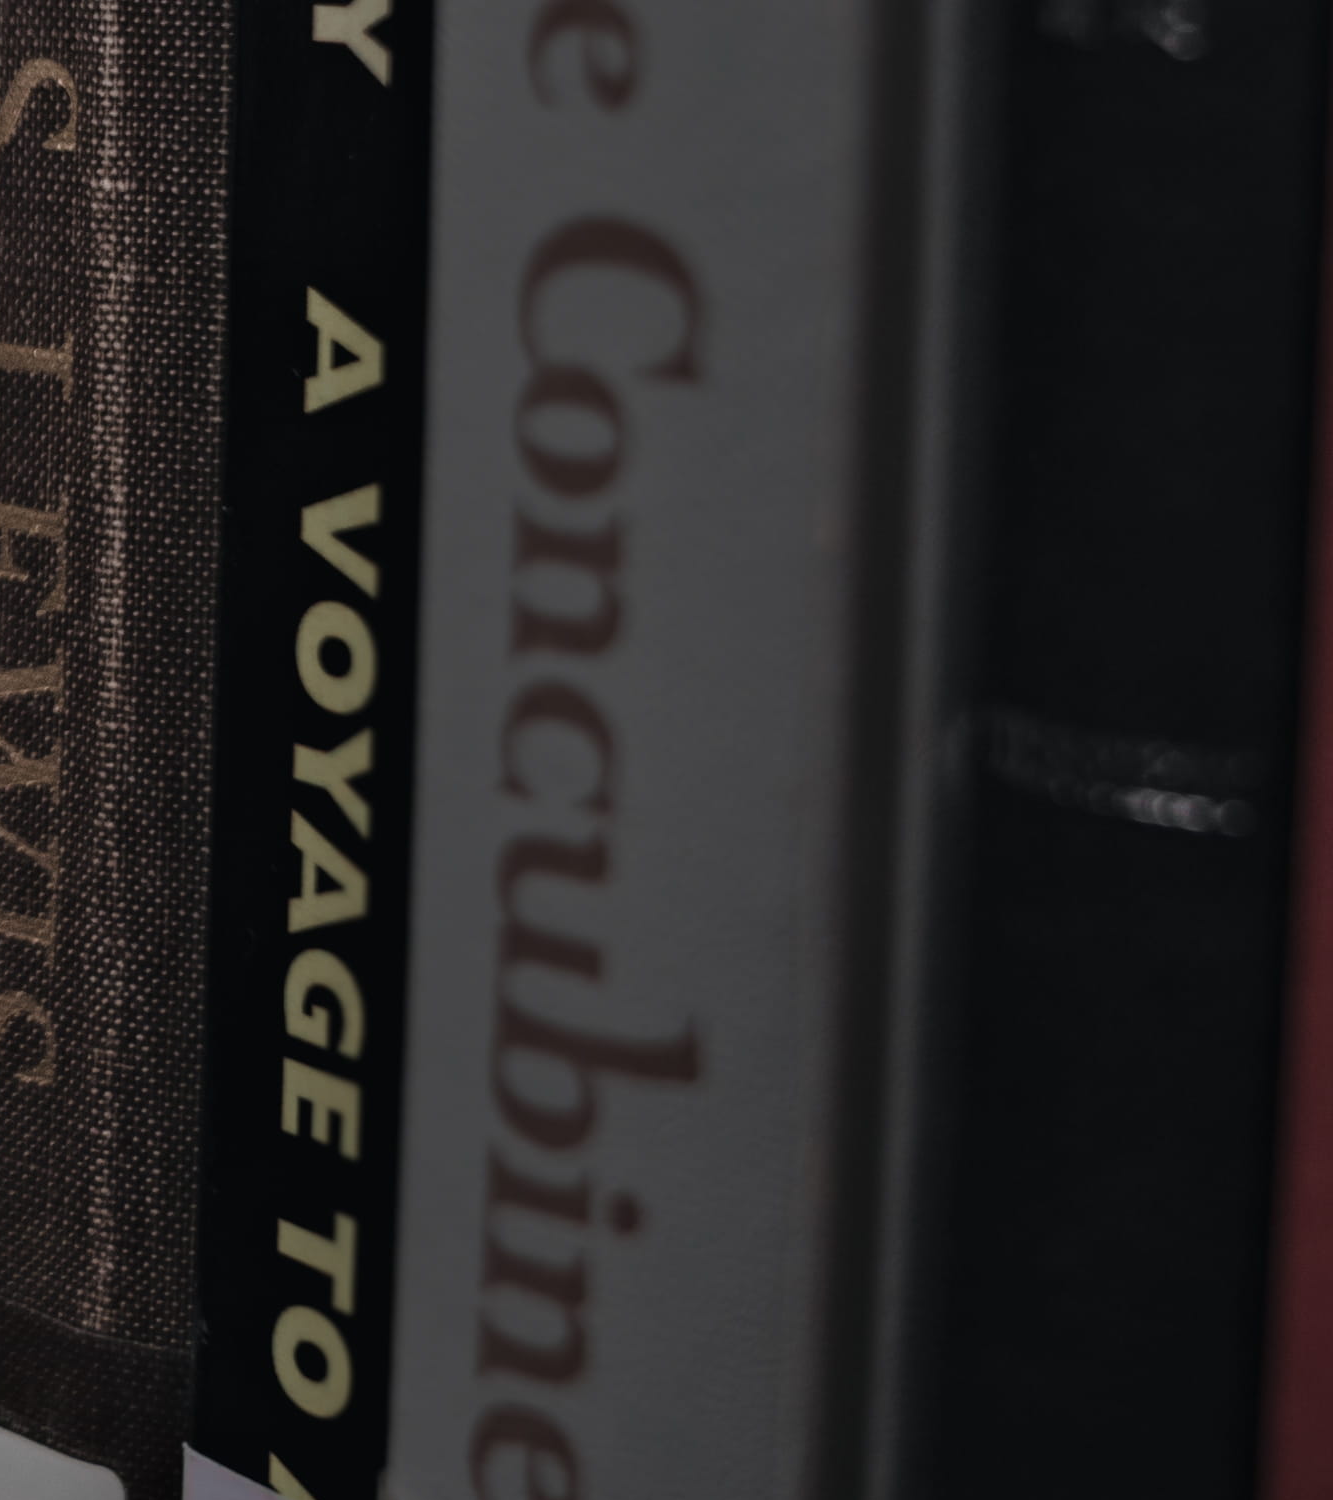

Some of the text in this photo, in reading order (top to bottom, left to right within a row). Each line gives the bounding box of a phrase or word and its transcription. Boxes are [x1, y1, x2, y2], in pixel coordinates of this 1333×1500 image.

[302, 285, 386, 416] A
[280, 481, 383, 1162] VOYAGE
[269, 1208, 358, 1421] TO
